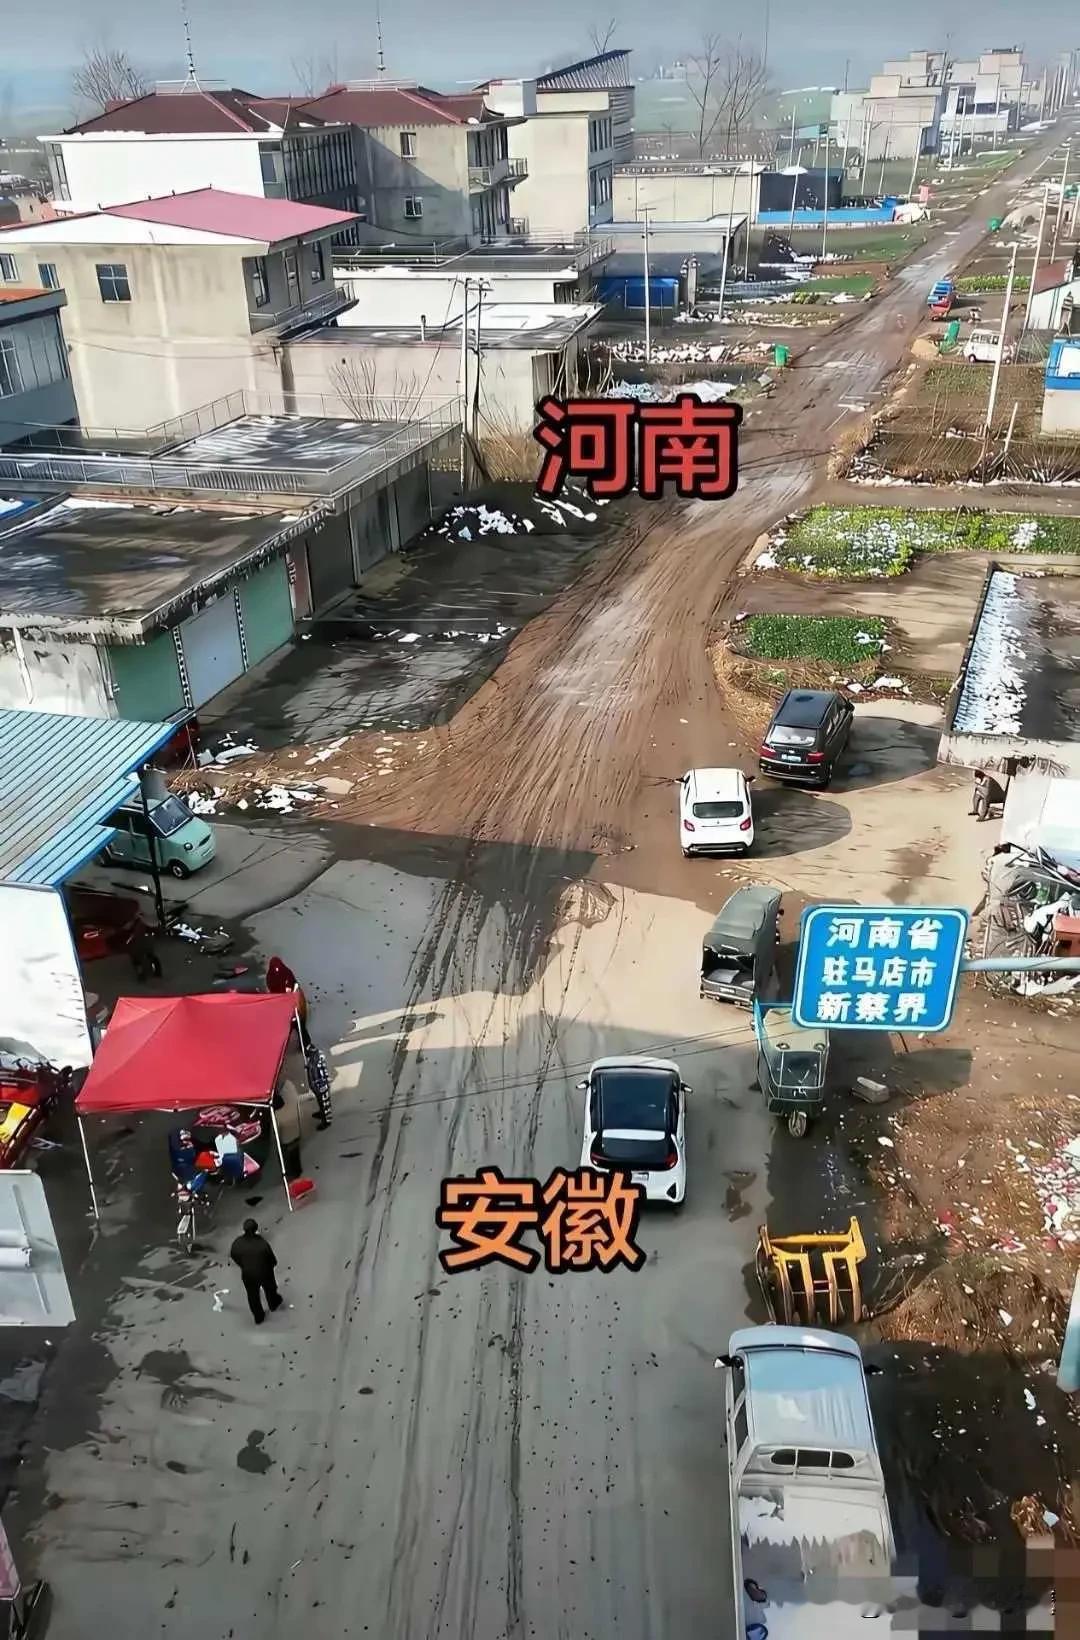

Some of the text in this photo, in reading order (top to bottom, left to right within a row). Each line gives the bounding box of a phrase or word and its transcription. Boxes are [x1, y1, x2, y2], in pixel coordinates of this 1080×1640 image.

[826, 917, 943, 950] 河南省
[821, 956, 938, 988] 驻马店市
[817, 992, 928, 1023] 新蔡界
